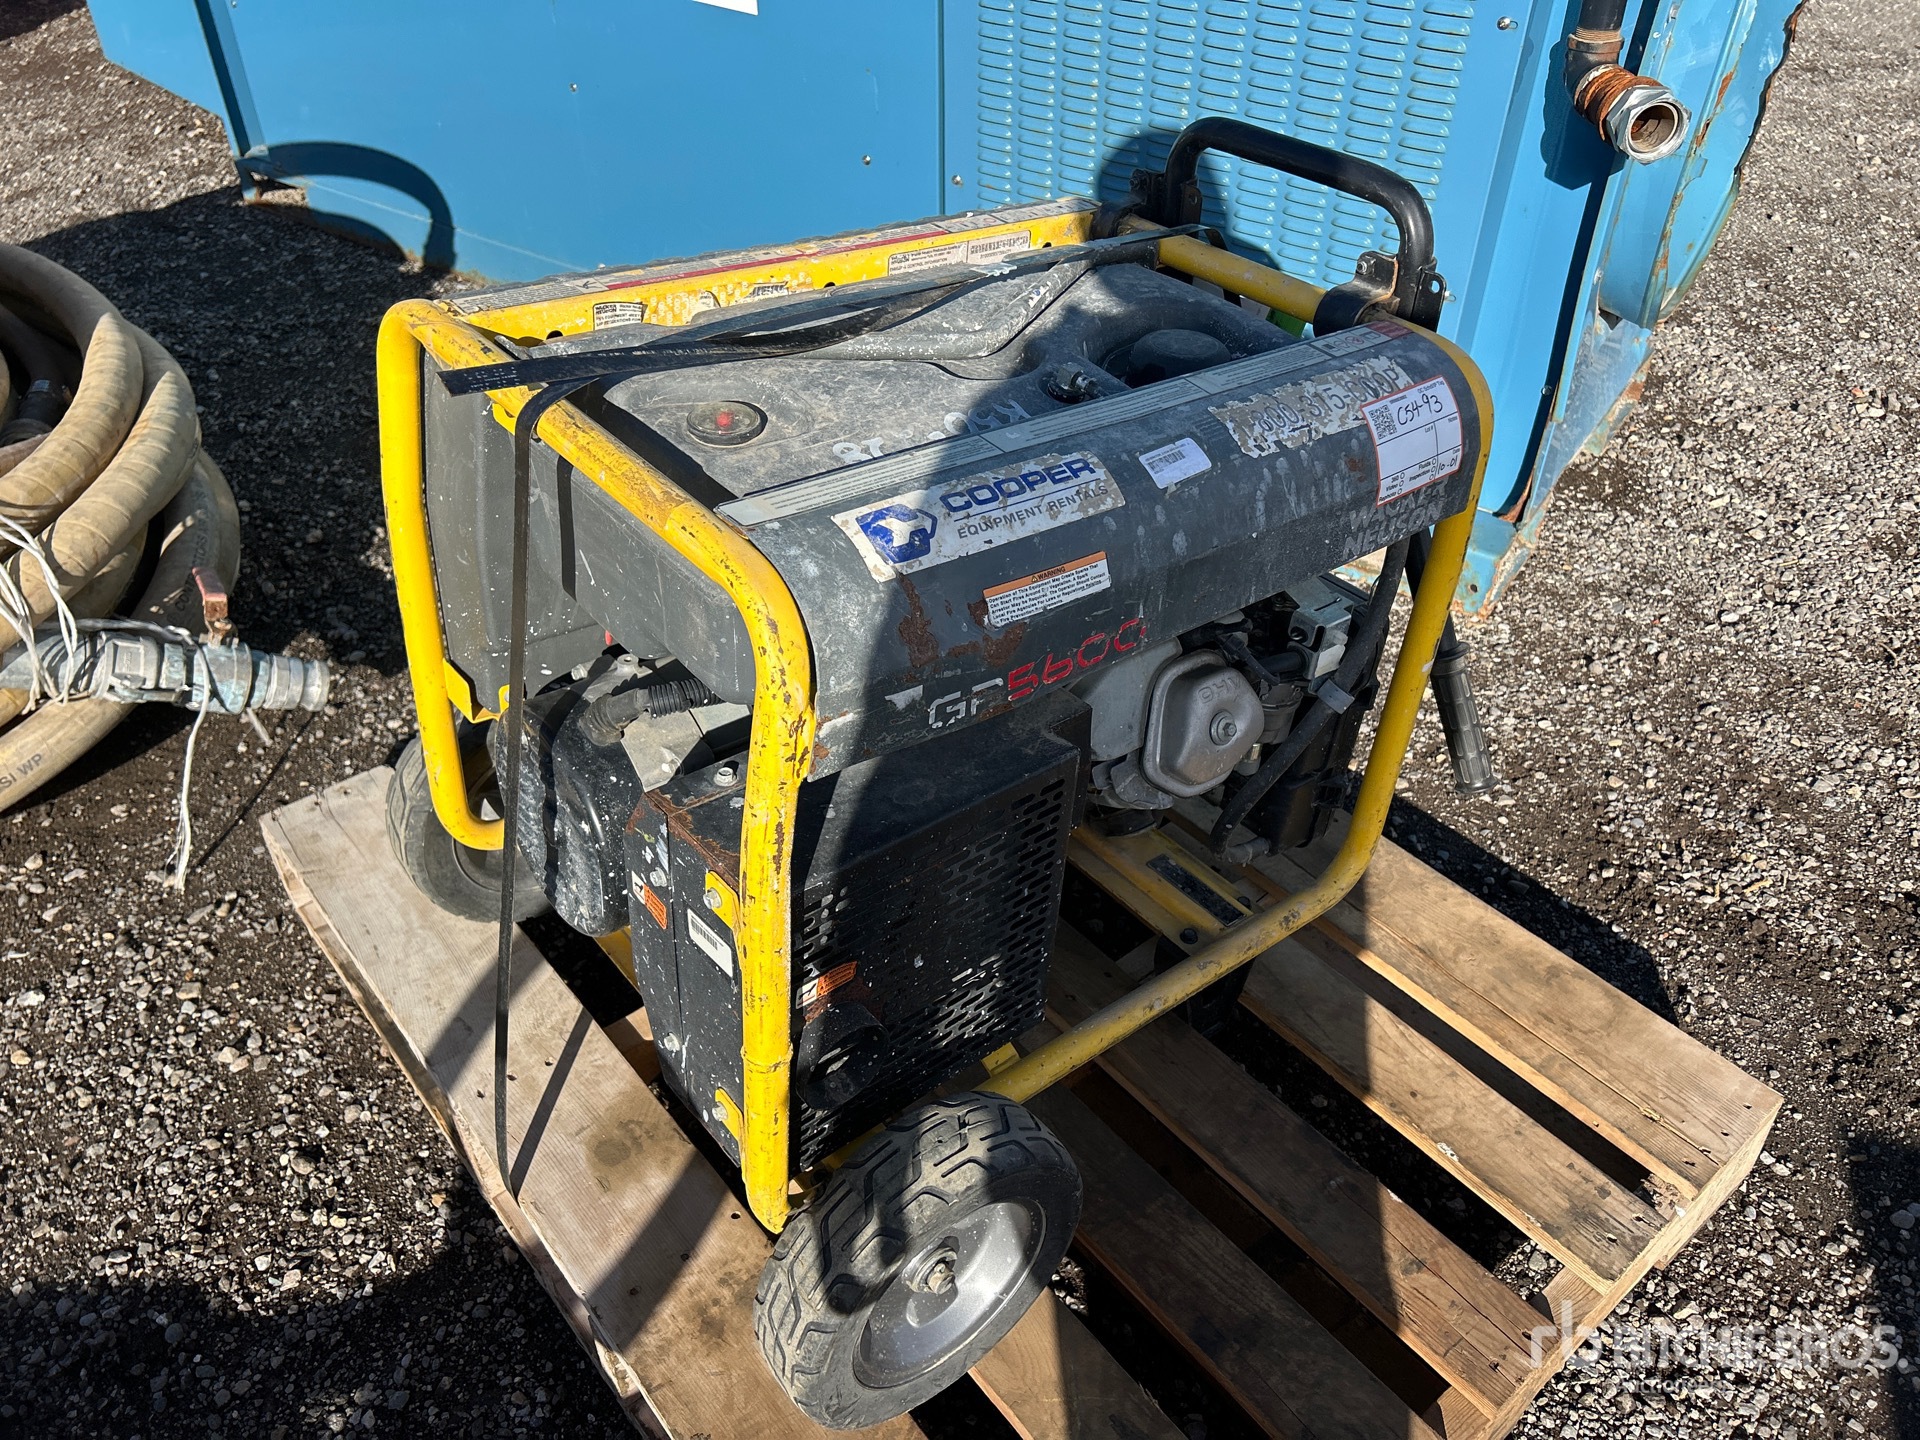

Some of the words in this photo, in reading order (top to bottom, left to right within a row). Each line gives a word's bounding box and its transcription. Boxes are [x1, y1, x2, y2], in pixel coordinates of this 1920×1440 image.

[1397, 393, 1443, 425] C54-93
[939, 458, 1096, 513] COOPER
[958, 505, 1042, 539] EQUIPMENT
[1049, 484, 1109, 511] RENTALS
[988, 593, 1011, 604] Operation
[1028, 580, 1051, 592] Equipment
[1089, 563, 1098, 571] That
[1038, 565, 1066, 581] WARNING
[991, 604, 1011, 615] Arrestor
[1057, 582, 1076, 593] Operator
[1076, 577, 1089, 586] Should
[1090, 572, 1106, 582] Contact
[1006, 607, 1016, 616] Fire
[1016, 601, 1037, 614] Agencies
[1013, 595, 1024, 603] Fires
[1025, 589, 1040, 599] Around
[16, 753, 42, 776] WP
